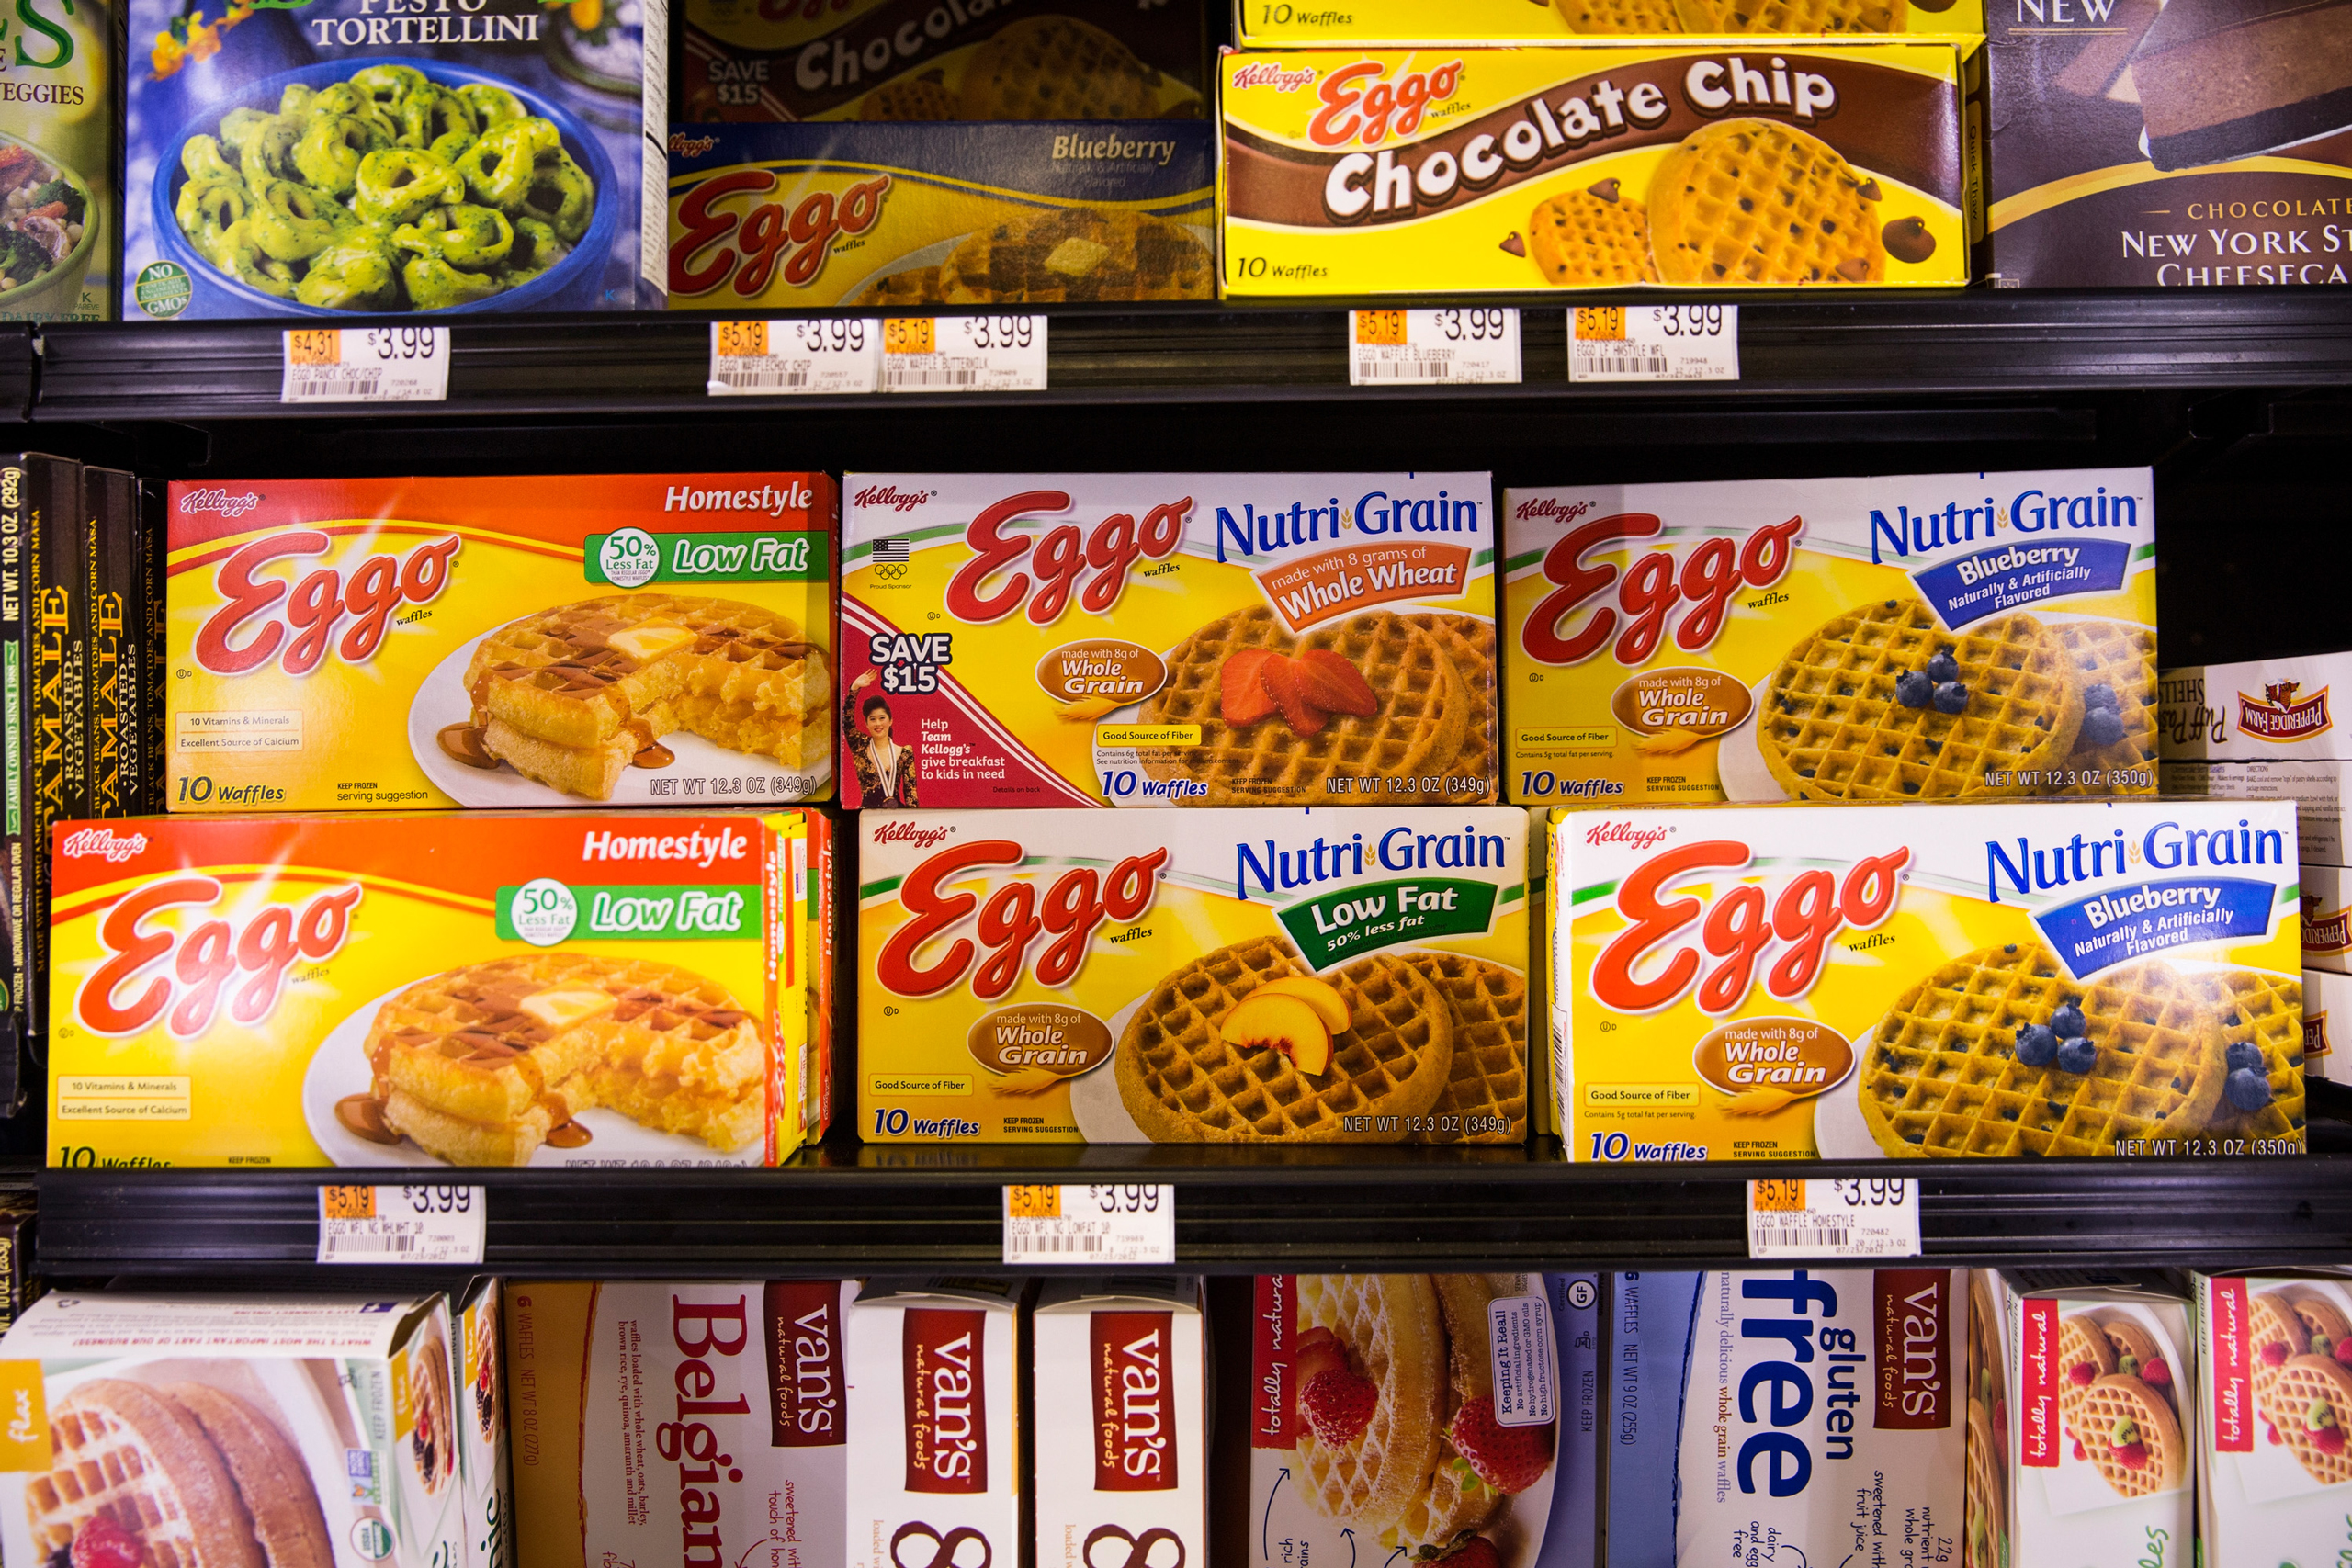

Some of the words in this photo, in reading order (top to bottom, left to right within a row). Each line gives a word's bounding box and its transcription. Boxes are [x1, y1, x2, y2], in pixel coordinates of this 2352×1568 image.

[1261, 4, 1293, 27] 10
[1296, 9, 1353, 27] Waffles
[2017, 0, 2113, 23] NEW
[311, 14, 539, 46] TORTELLINI
[707, 59, 770, 83] SAVE
[1308, 60, 1463, 148] Eggo
[1051, 134, 1177, 165] Blueberry
[1325, 77, 1668, 217] Chocolate
[1685, 57, 1836, 118] Chip
[1969, 124, 1978, 174] Quick
[1970, 179, 1980, 221] Thaw
[833, 239, 865, 255] waffles
[148, 265, 173, 281] NO
[1577, 307, 1619, 331] $5.19
[1653, 306, 1722, 336] $3.99
[368, 327, 435, 359] $3.99
[292, 368, 311, 380] EGGO
[314, 368, 337, 380] PANCK
[887, 357, 906, 368] EGGO
[910, 357, 938, 368] WAFFLE
[943, 357, 989, 368] BUTTERMILK
[1, 467, 20, 508] (292g)
[664, 481, 813, 517] Homestyle
[1, 511, 18, 535] OZ.
[1516, 498, 1588, 523] Kellogg's
[1216, 497, 1340, 563] Nutri
[1355, 491, 1478, 536] Grain
[3, 536, 18, 566] 10.3
[609, 536, 656, 560] 50%
[946, 491, 1193, 625] Eggo
[606, 559, 632, 570] Less
[636, 558, 654, 570] Fat
[1956, 547, 2081, 586] Blueberry
[2, 567, 18, 593] WT.
[1522, 513, 1802, 665] Eggo
[2, 594, 18, 622] NET
[196, 531, 460, 674] Eggo
[1061, 659, 1122, 677] Whole
[1639, 677, 1668, 687] made
[1670, 677, 1693, 687] with
[1696, 676, 1709, 689] 8g
[1711, 676, 1722, 686] of
[1638, 688, 1704, 707] Whole
[922, 718, 948, 730] Help
[1521, 733, 1545, 742] Good
[1547, 733, 1575, 742] Source
[1577, 732, 1587, 741] of
[1588, 732, 1609, 741] Fiber
[181, 738, 219, 748] Excellent
[221, 738, 250, 747] Source
[253, 737, 262, 746] of
[265, 737, 299, 746] Calcium
[922, 756, 947, 768] give
[949, 756, 1005, 767] breakfast
[178, 775, 212, 803] 10
[219, 786, 285, 804] Waffles
[1984, 772, 2013, 786] NET
[2018, 772, 2040, 786] WT
[2046, 771, 2076, 785] 12.3
[2082, 771, 2100, 785] OZ
[2106, 770, 2154, 788] (350g)
[337, 791, 373, 802] serving
[376, 790, 428, 801] suggestion
[582, 828, 748, 867] Homestyle
[1237, 833, 1363, 901] Nutri
[1377, 825, 1506, 872] Grain
[523, 888, 573, 915] 50%
[2083, 884, 2222, 931] Blueberry
[518, 914, 548, 926] Less
[551, 914, 571, 925] Fat
[877, 840, 1167, 998] Eggo
[1592, 840, 1910, 1013] Eggo
[78, 877, 362, 1036] Eggo
[291, 967, 331, 985] waffles
[996, 1026, 1063, 1045] Whole
[1724, 1040, 1799, 1062] Whole
[875, 1080, 899, 1089] Good
[900, 1080, 930, 1089] Source
[932, 1080, 942, 1089] of
[944, 1080, 965, 1089] Fiber
[1591, 1090, 1617, 1100] Good
[1620, 1089, 1652, 1100] Source
[1654, 1089, 1665, 1100] of
[1667, 1089, 1690, 1100] Fiber
[62, 1105, 103, 1115] Excellent
[105, 1105, 136, 1114] Source
[140, 1104, 148, 1114] of
[151, 1104, 187, 1115] Calcium
[1343, 1117, 1370, 1132] NET
[1376, 1116, 1399, 1132] WT
[1405, 1116, 1435, 1131] 12.3
[1441, 1116, 1459, 1131] OZ
[1464, 1115, 1511, 1134] (349g)
[2115, 1140, 2147, 1156] NET
[2152, 1139, 2177, 1156] WT
[2183, 1139, 2217, 1156] 12.3
[2222, 1139, 2245, 1155] OZ
[2251, 1138, 2303, 1155] (350g)
[1758, 1179, 1798, 1201] $5.19
[1834, 1179, 1904, 1206] $3.99
[328, 1223, 346, 1235] EGGO
[351, 1223, 363, 1235] WFL
[368, 1223, 378, 1234] NG
[414, 1222, 424, 1234] 10
[1577, 1286, 1588, 1303] GF
[618, 1321, 628, 1351] brown
[630, 1319, 641, 1352] waffles
[1495, 1310, 1509, 1344] Real!
[1510, 1311, 1521, 1359] ingredients
[777, 1316, 791, 1383] natural
[1498, 1349, 1509, 1358] It
[2030, 1310, 2047, 1385] natural
[619, 1353, 629, 1374] rice,
[631, 1354, 642, 1385] loaded
[794, 1303, 837, 1434] van's
[1515, 1359, 1523, 1397] artificial
[618, 1375, 628, 1393] rye,
[915, 1344, 931, 1419] natural
[1501, 1360, 1513, 1414] Keeping
[1582, 1371, 1594, 1406] FROZEN
[1820, 1327, 1867, 1460] gluten
[633, 1388, 643, 1408] with
[777, 1385, 791, 1427] foods
[1517, 1398, 1524, 1410] No
[8, 1388, 39, 1443] flax
[619, 1395, 631, 1431] quinoa,
[635, 1410, 645, 1438] whole
[1581, 1410, 1592, 1432] KEEP
[2029, 1386, 2052, 1459] totally
[655, 1293, 751, 1568] Belgian
[624, 1432, 636, 1475] amaranth
[636, 1440, 646, 1471] wheat,
[913, 1421, 931, 1470] foods
[627, 1479, 637, 1495] and
[637, 1472, 646, 1494] oats,
[628, 1497, 639, 1525] millet
[639, 1495, 650, 1526] barley,
[786, 1479, 797, 1542] sweetened
